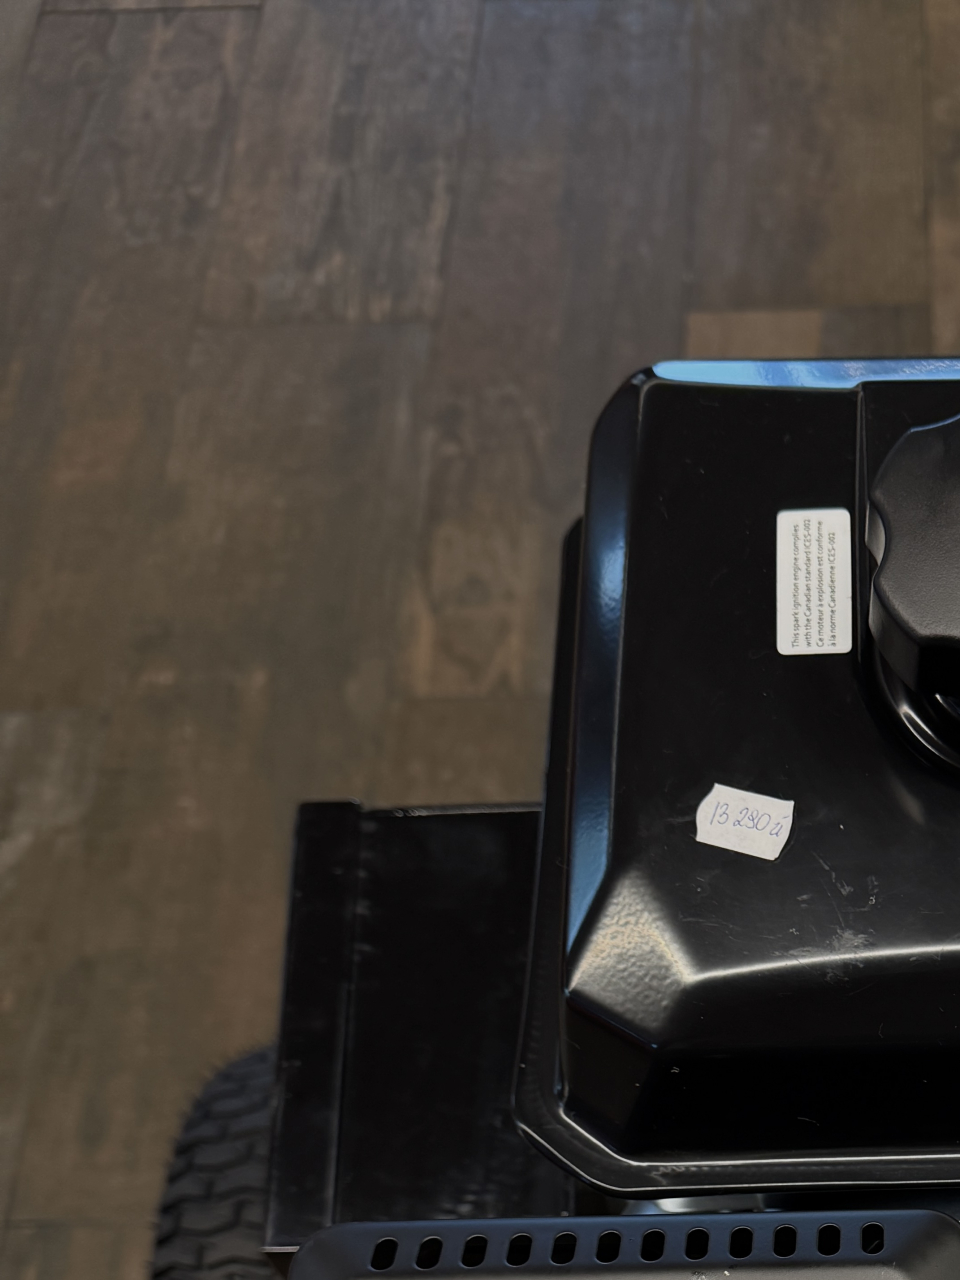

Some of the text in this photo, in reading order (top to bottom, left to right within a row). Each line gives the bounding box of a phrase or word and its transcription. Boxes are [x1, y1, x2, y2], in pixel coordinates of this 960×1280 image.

[792, 525, 801, 555] complies
[828, 532, 836, 564] ICES-002
[792, 558, 801, 581] engine
[792, 583, 801, 610] ignition
[816, 568, 826, 602] explosion
[828, 566, 836, 608] Canadienne
[792, 612, 801, 631] spark
[816, 609, 824, 636] moteur
[816, 637, 824, 647] Ce
